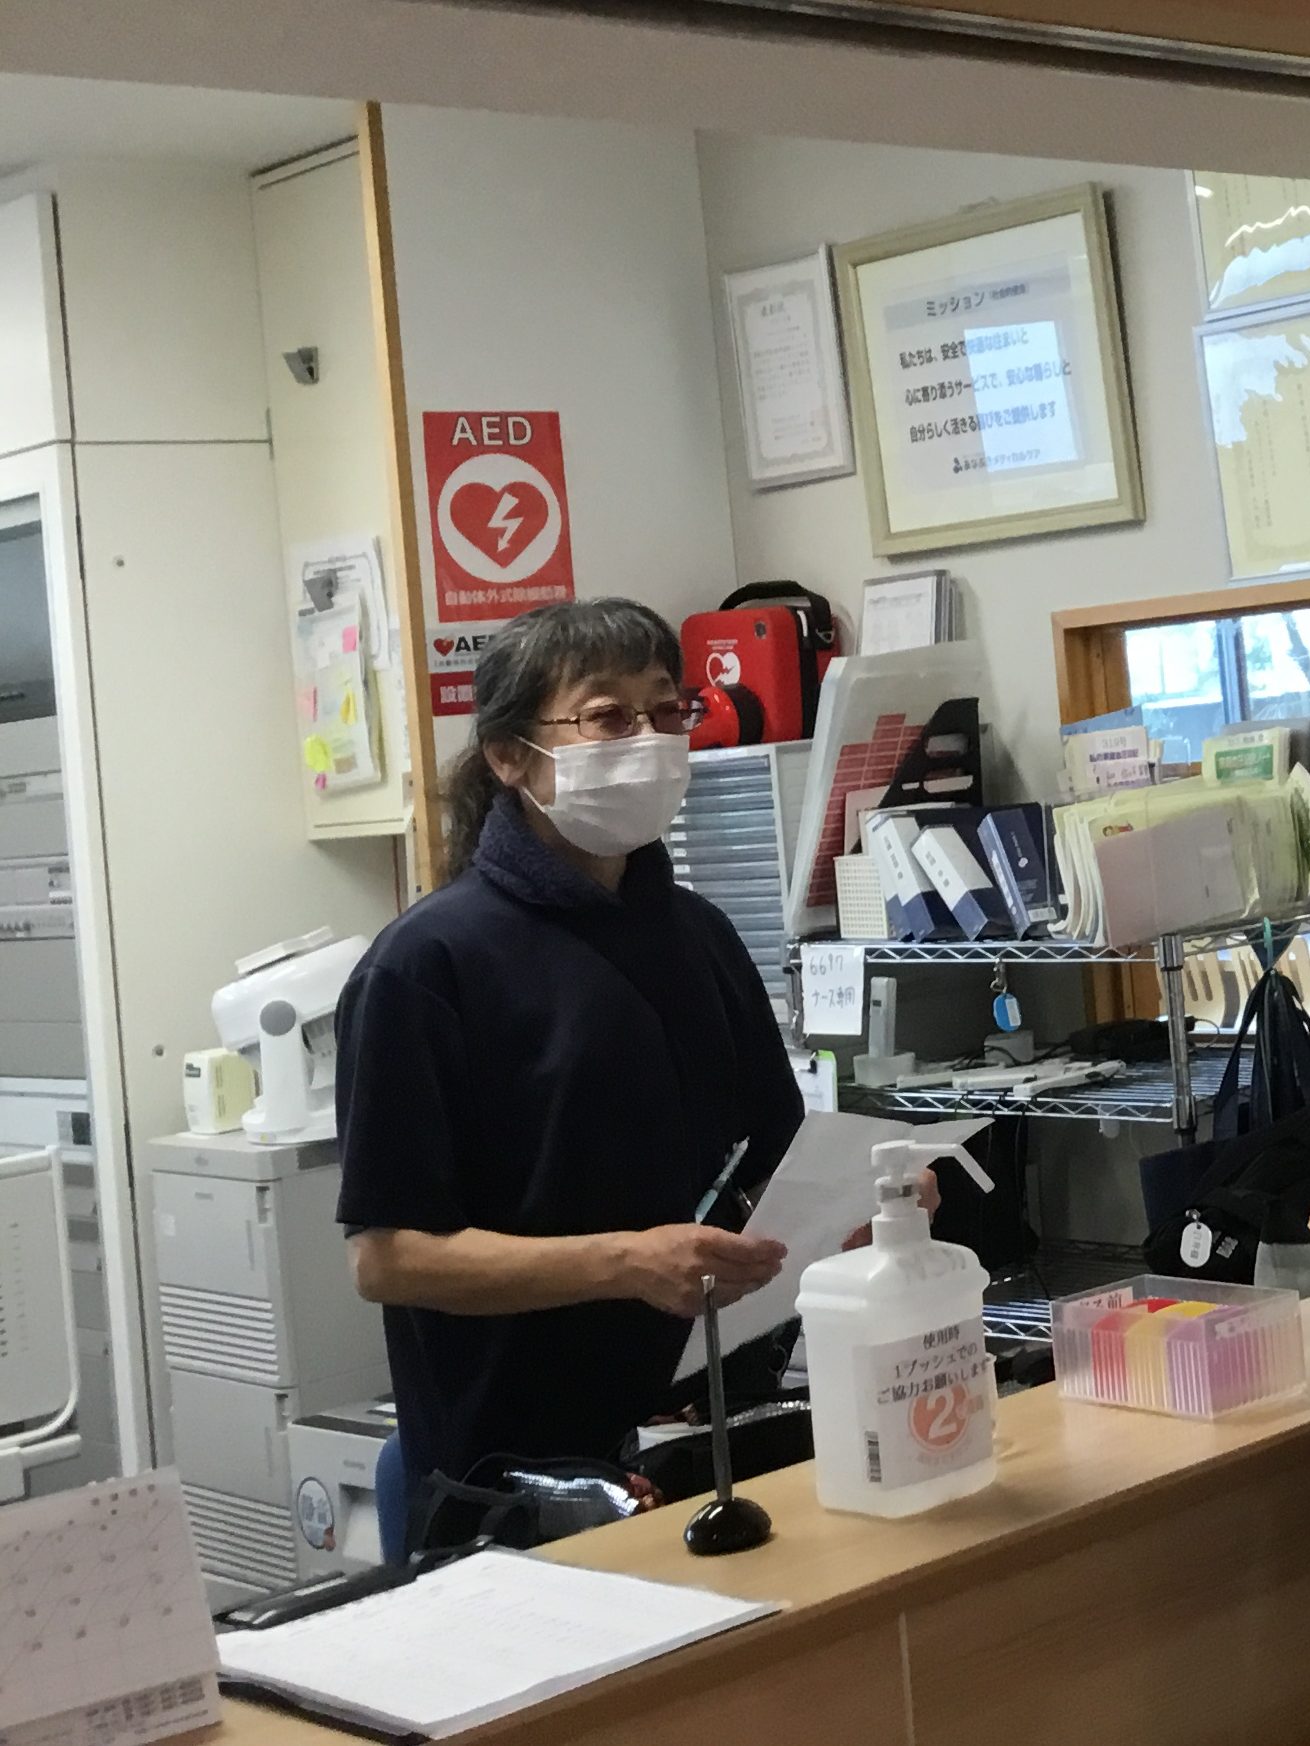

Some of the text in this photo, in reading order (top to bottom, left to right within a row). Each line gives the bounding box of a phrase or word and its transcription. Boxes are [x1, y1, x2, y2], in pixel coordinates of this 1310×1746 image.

[926, 291, 985, 317] ミッション
[451, 416, 533, 446] AED
[455, 634, 496, 653] AE
[923, 1324, 960, 1350] 使用時
